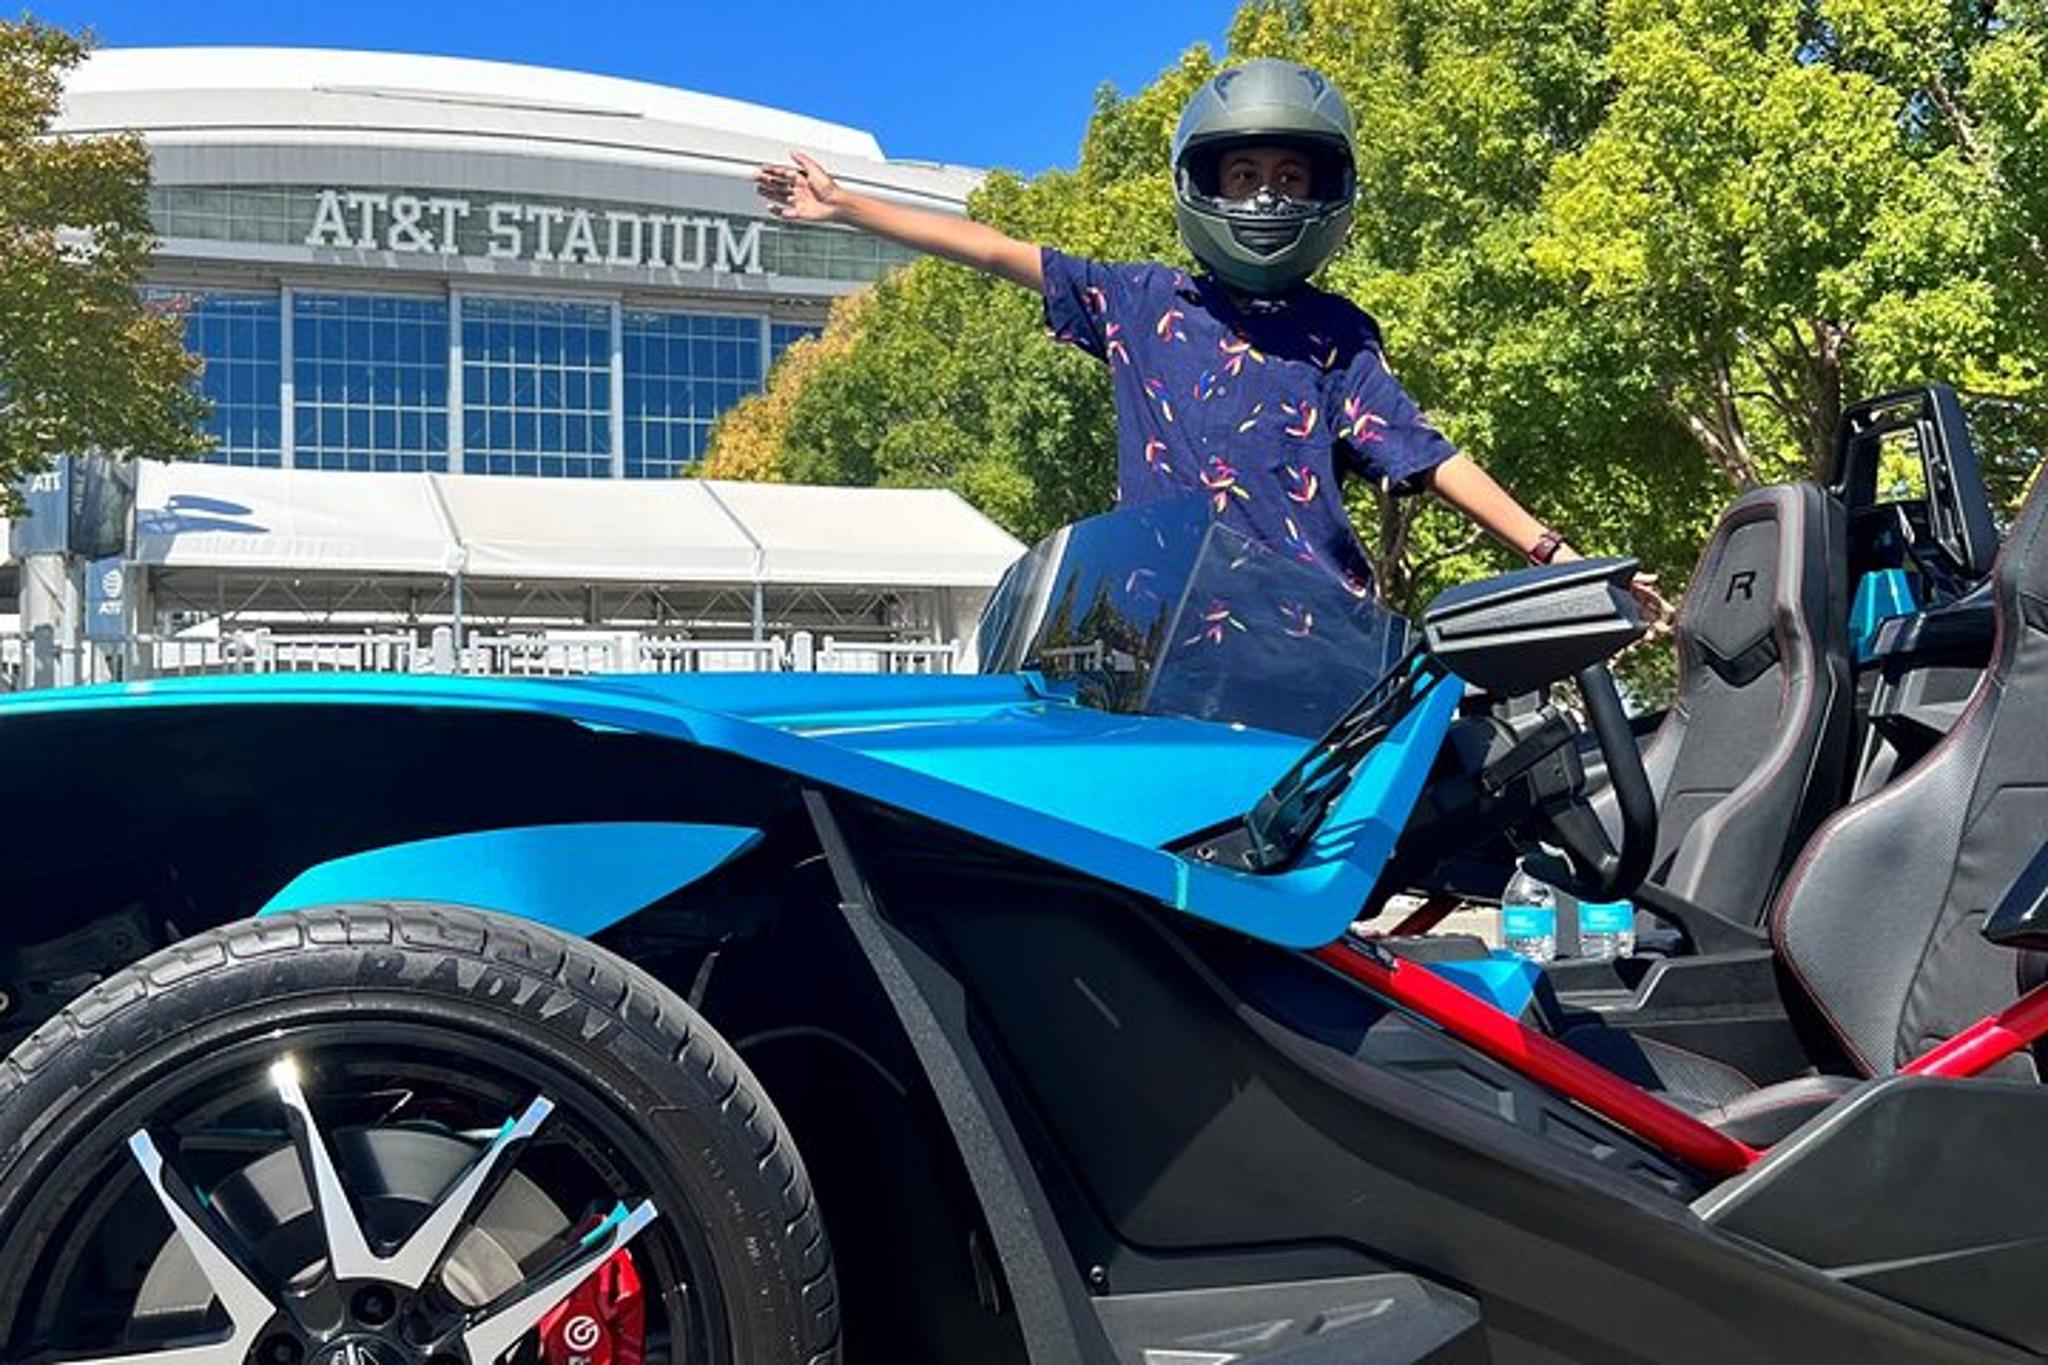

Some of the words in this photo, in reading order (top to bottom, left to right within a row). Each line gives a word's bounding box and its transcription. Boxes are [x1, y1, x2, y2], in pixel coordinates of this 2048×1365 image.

[304, 189, 471, 255] AT&T
[487, 203, 768, 275] STADIUM
[1725, 571, 1756, 603] R
